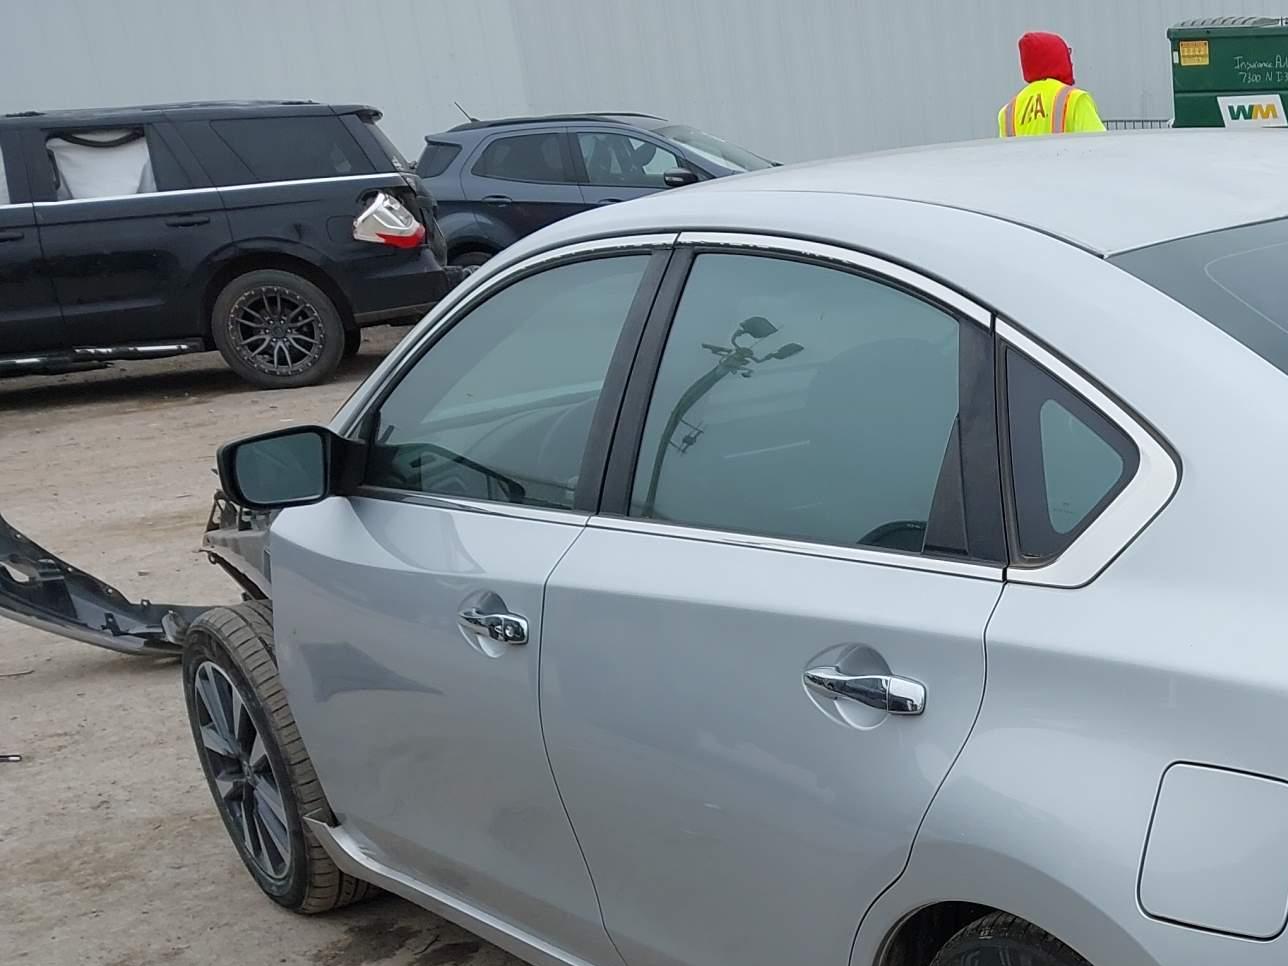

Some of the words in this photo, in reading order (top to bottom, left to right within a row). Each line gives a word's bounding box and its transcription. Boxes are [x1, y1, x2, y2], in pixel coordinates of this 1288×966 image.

[1239, 71, 1262, 83] 7300
[1265, 71, 1273, 81] N
[1227, 103, 1279, 121] WM
